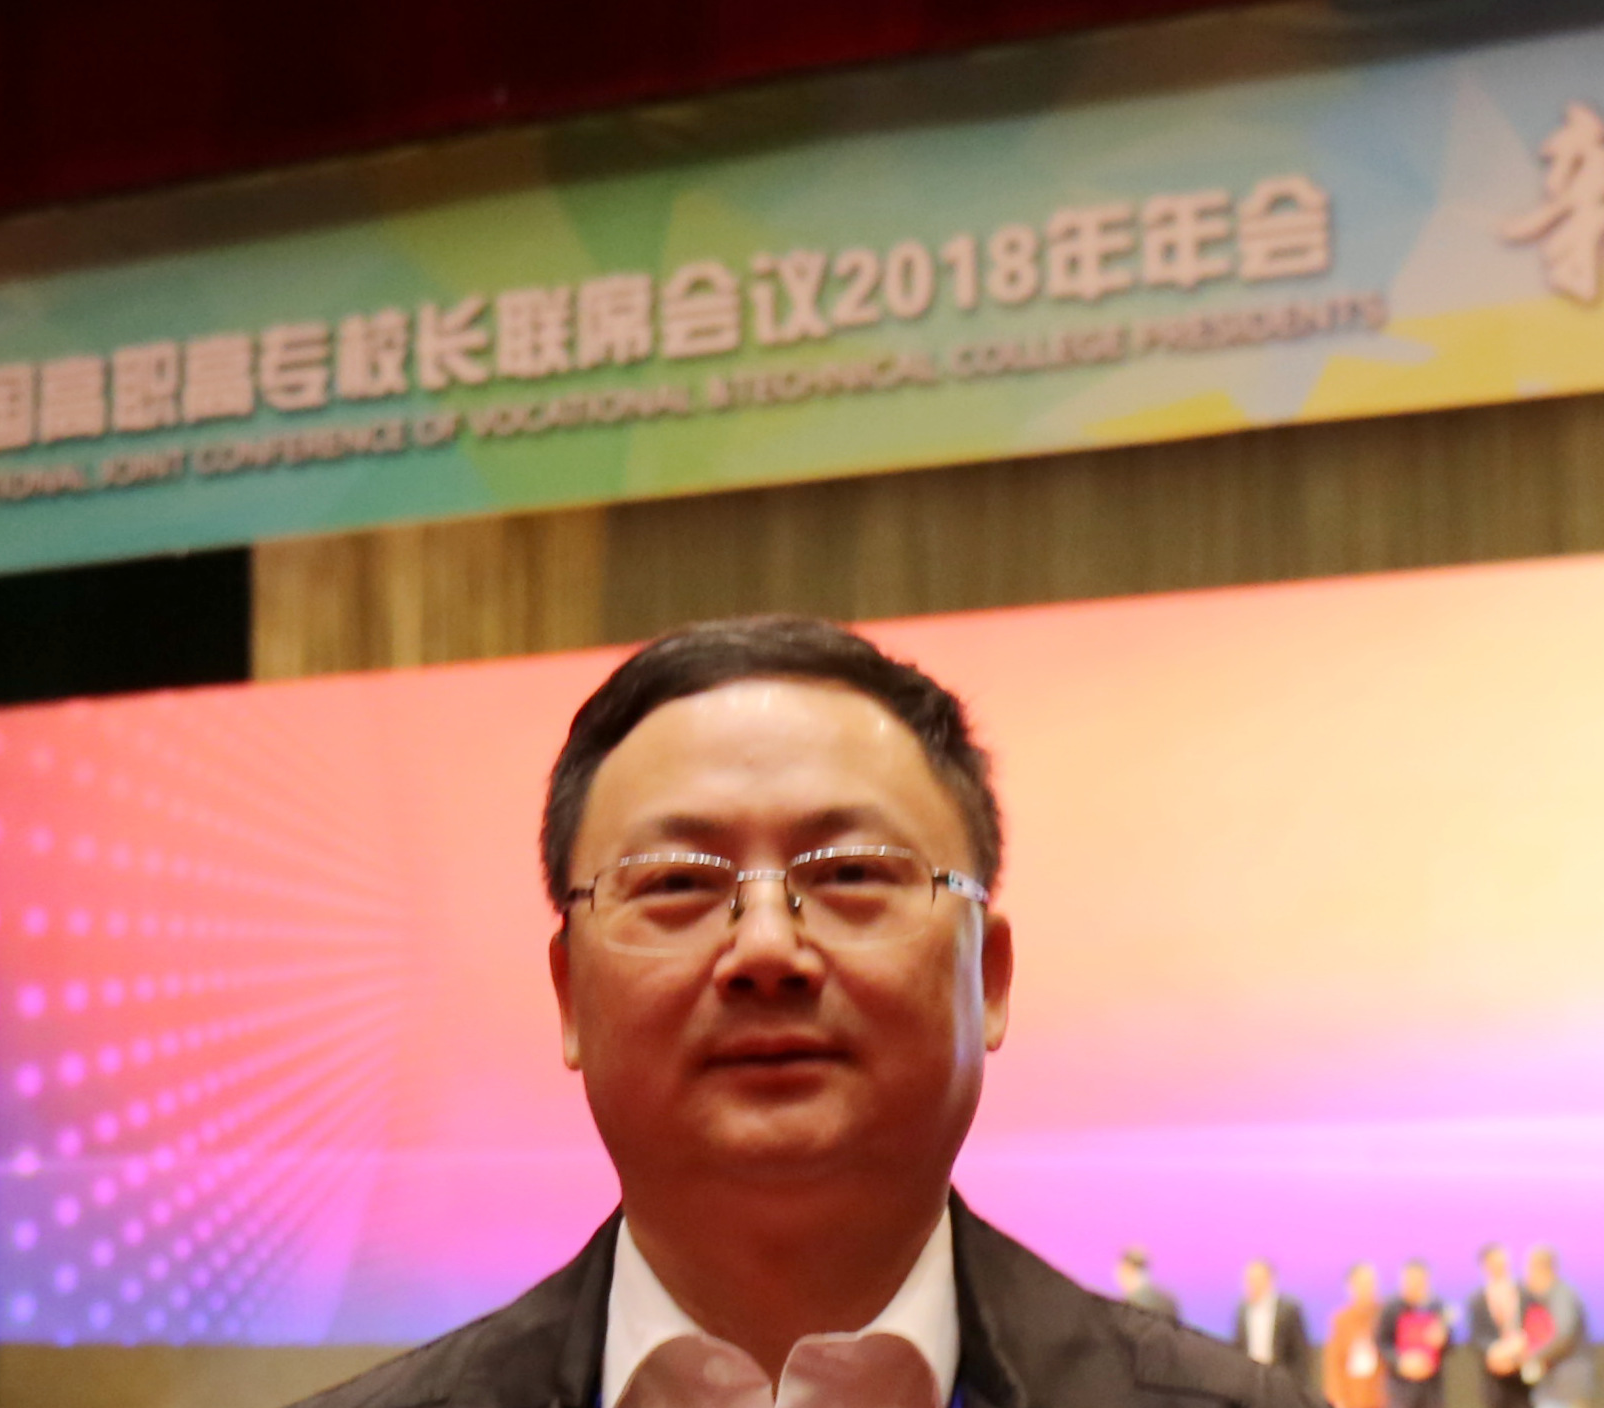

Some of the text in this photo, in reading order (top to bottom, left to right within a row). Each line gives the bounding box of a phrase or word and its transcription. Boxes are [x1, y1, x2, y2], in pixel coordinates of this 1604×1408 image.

[100, 448, 184, 486] JOINT
[196, 415, 405, 477] CONFERENCE
[412, 411, 458, 448] OF
[466, 385, 692, 439] VOCATIONAL
[950, 327, 1125, 376] COLLEGE
[1130, 290, 1388, 354] PRESIDENTS
